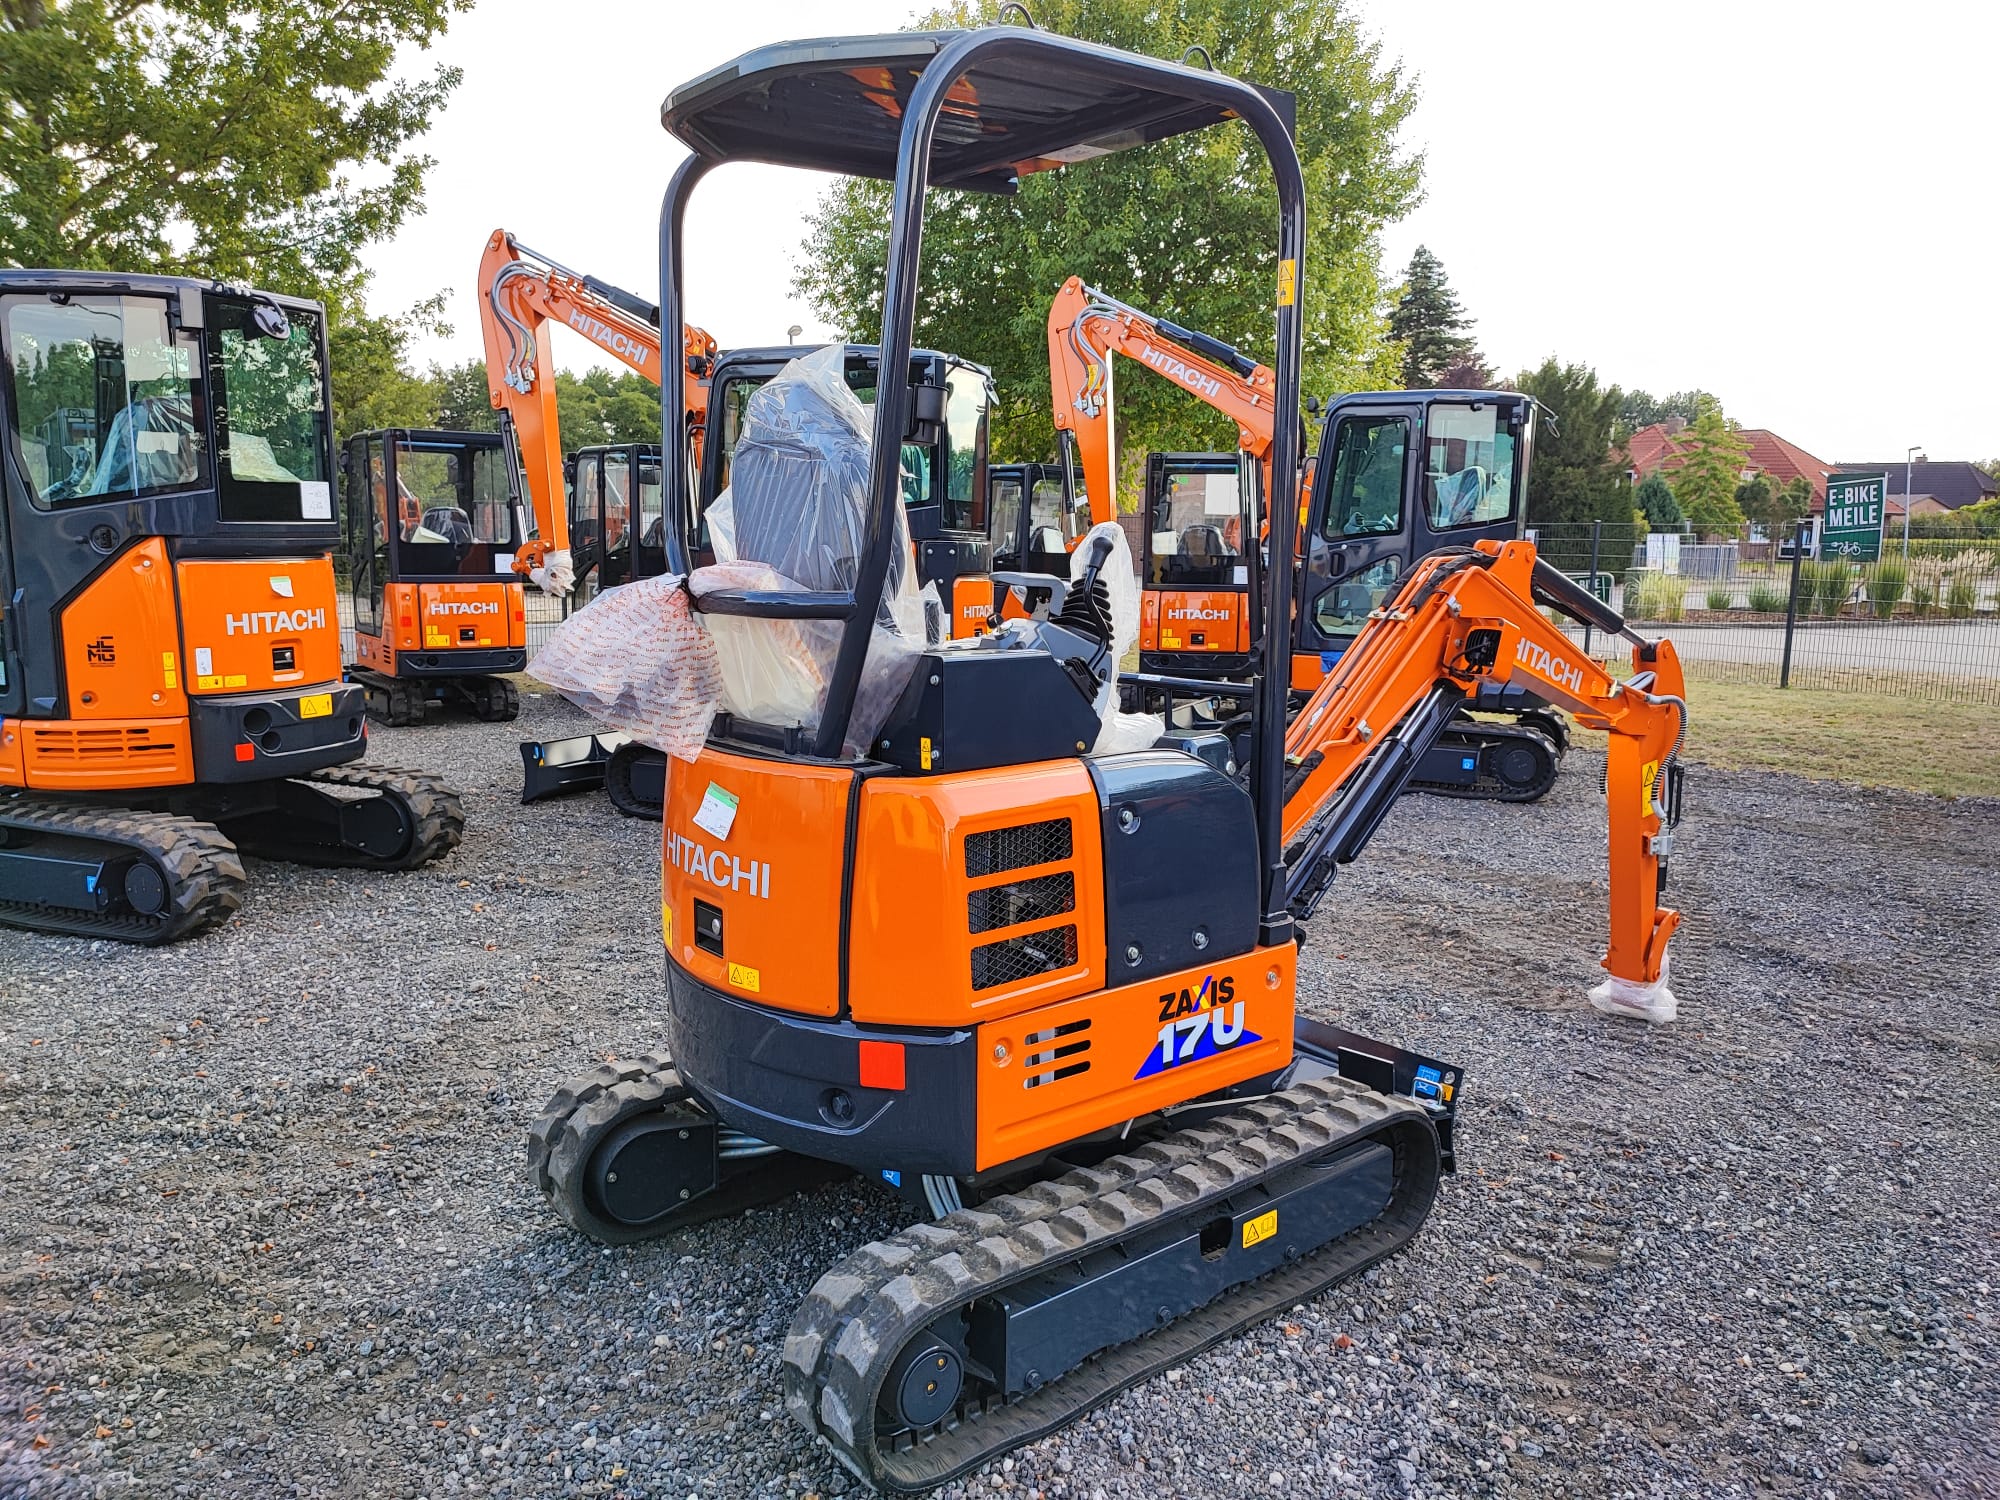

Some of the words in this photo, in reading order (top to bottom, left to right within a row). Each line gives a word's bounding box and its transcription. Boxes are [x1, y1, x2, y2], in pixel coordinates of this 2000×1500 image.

[568, 308, 649, 366] HITACHI
[1141, 345, 1222, 398] HITACHI
[1829, 485, 1878, 507] E-BIKE
[1829, 505, 1878, 527] MEILE
[226, 608, 325, 636] HITACHI
[431, 602, 499, 615] HITACHI
[1168, 608, 1230, 621] HITACHI
[667, 828, 770, 899] HITACHI
[1159, 975, 1235, 1023] ZAXIS
[1157, 1001, 1245, 1068] 17U
